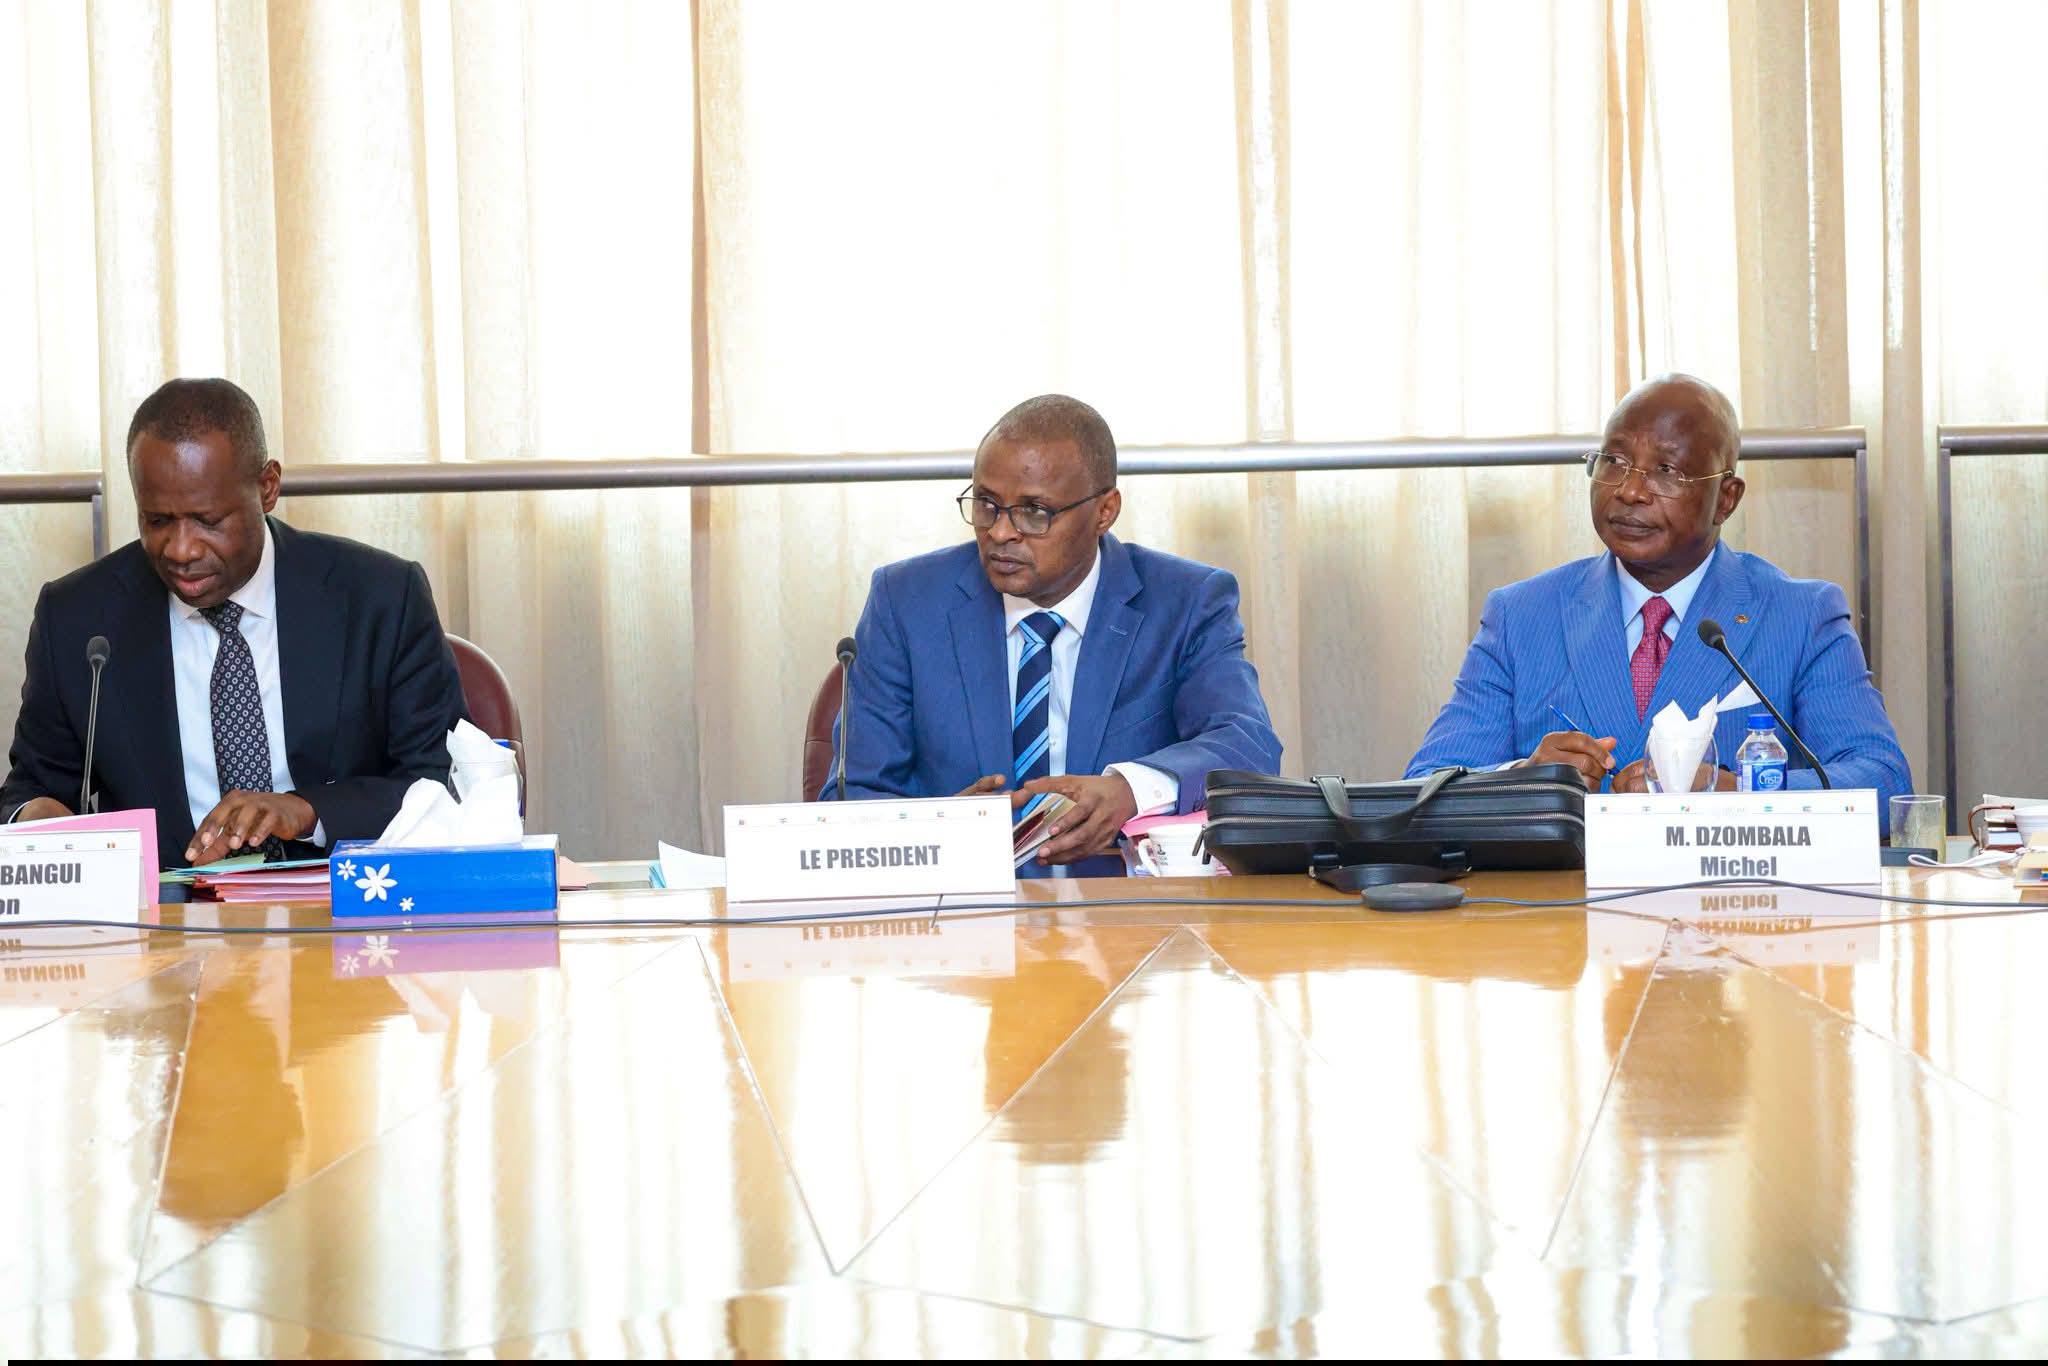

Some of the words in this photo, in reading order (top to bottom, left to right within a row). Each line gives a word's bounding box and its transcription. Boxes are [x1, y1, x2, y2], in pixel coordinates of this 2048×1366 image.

[1665, 826, 1690, 846] M.
[1695, 826, 1812, 847] DZOMBALA
[800, 850, 822, 870] LE
[827, 845, 941, 870] PRESIDENT
[1700, 856, 1778, 877] Michel
[0, 863, 82, 886] BANGUI
